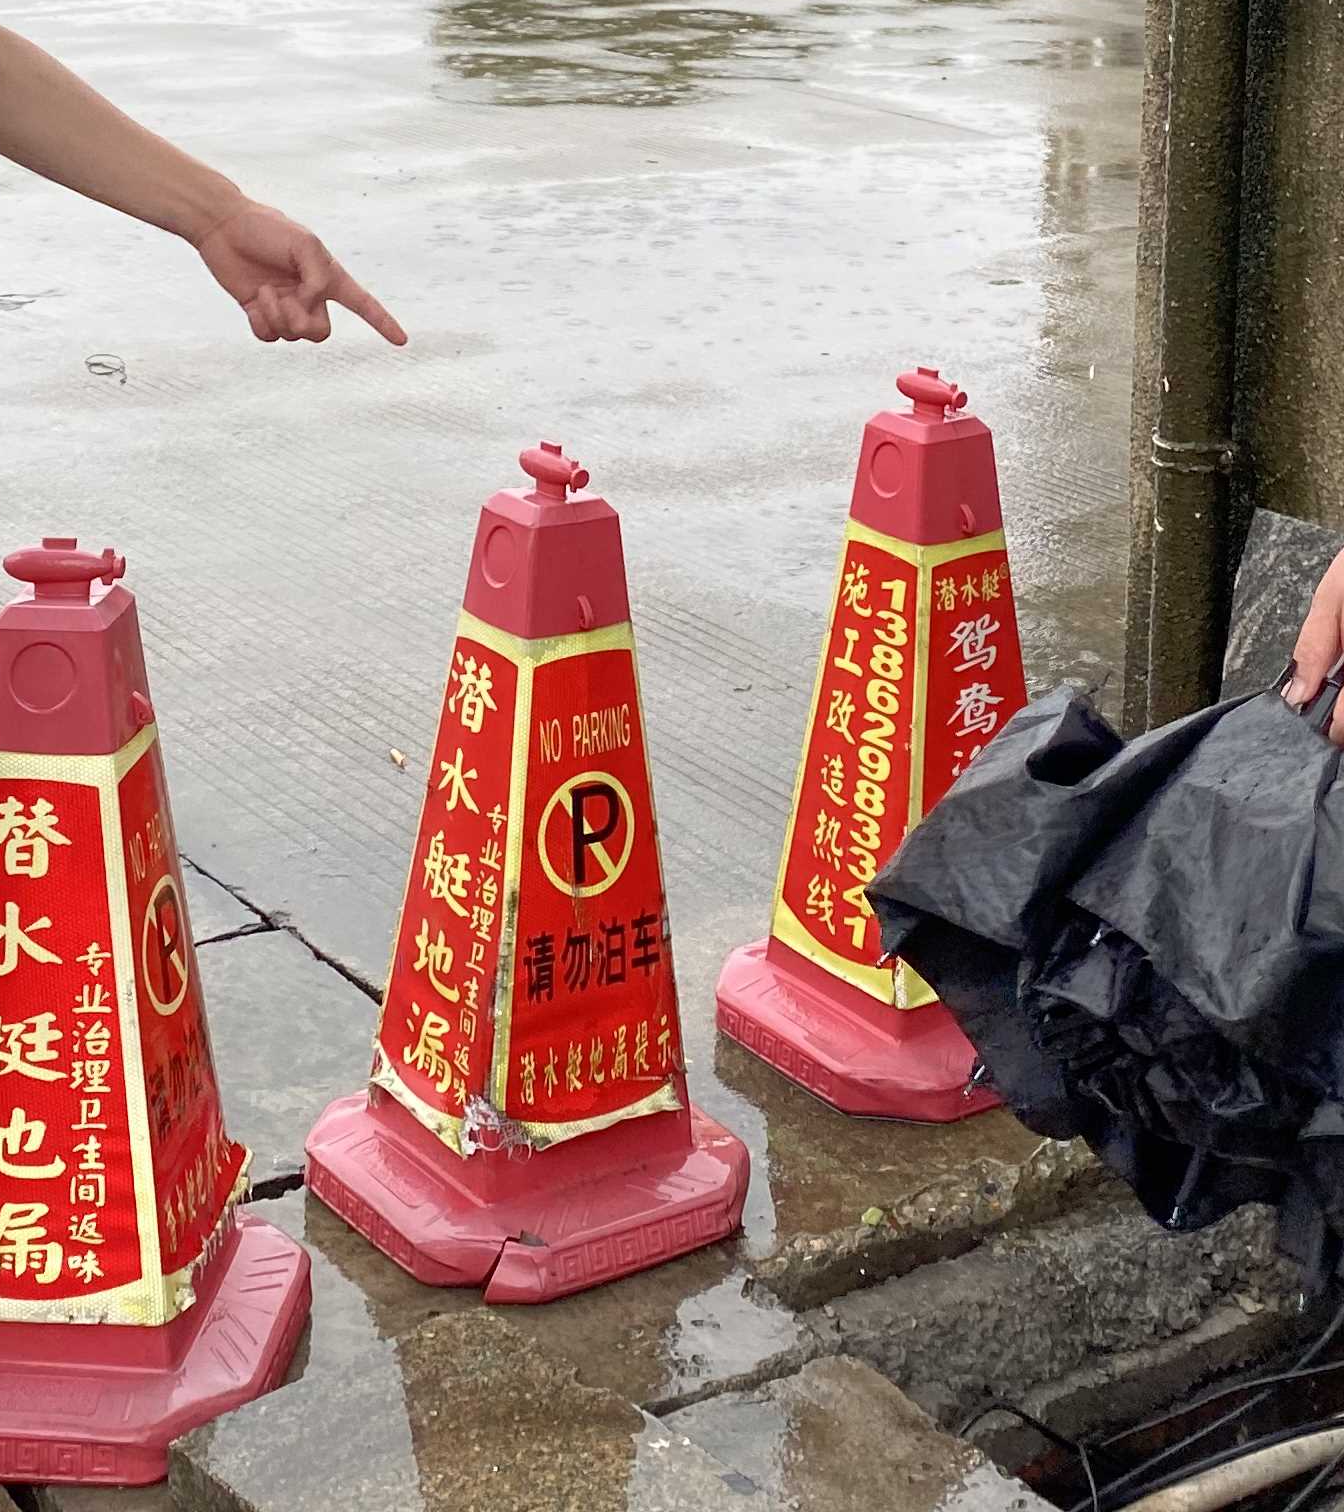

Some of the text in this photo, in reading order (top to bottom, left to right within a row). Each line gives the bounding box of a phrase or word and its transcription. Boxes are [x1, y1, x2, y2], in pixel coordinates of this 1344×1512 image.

[539, 703, 631, 764] NO PARKING
[805, 560, 872, 936] 施工改造热线
[842, 578, 908, 950] 13862983341
[944, 613, 1005, 777] 鸳鸯
[403, 651, 499, 1094] 潜水艇地漏
[569, 784, 620, 884] P
[523, 909, 660, 1004] 请勿泊车
[67, 942, 113, 1284] 专业治理卫生间返味
[520, 1014, 672, 1106] 潜水艇地漏提示
